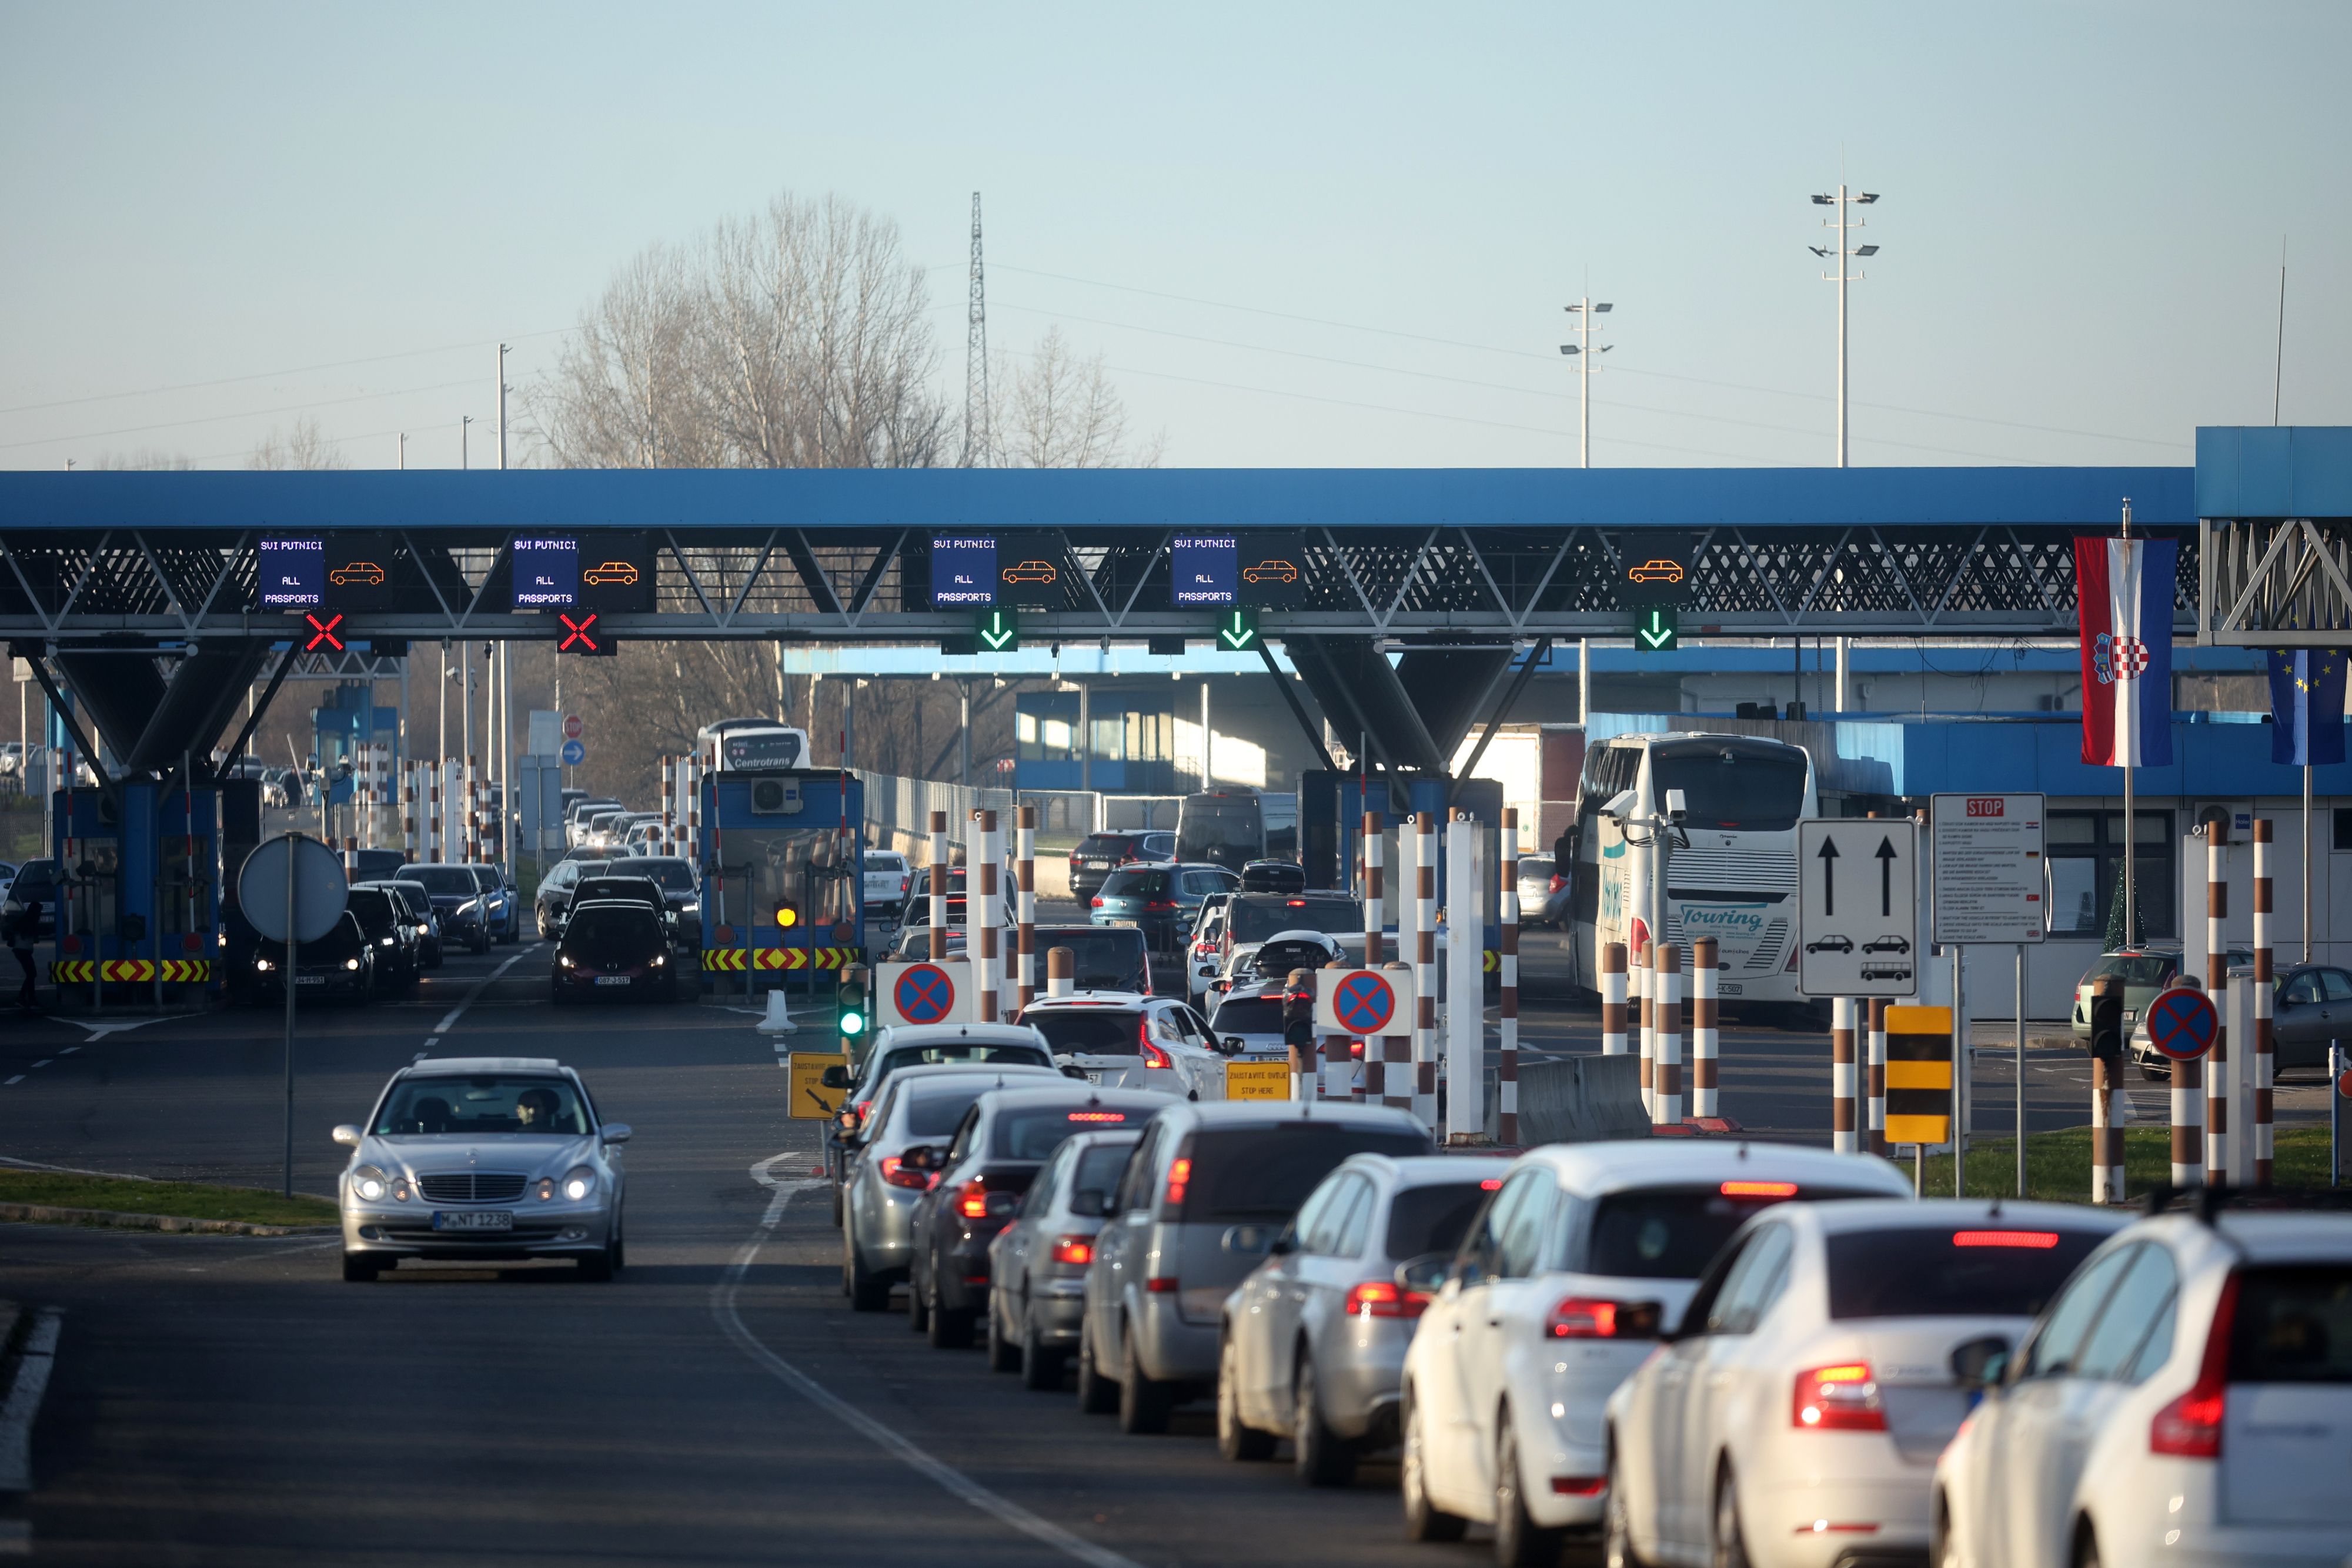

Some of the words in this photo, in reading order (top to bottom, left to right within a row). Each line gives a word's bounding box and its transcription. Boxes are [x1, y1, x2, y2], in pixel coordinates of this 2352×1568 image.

[514, 541, 531, 549] SVI
[535, 541, 575, 549] PUTNICI
[519, 594, 572, 603] PASSPORTS
[566, 722, 581, 732] STOP
[735, 757, 790, 767] Centrotrans
[1969, 800, 2002, 815] STOP
[1681, 904, 1768, 931] Touring
[441, 1213, 450, 1224] M
[458, 1213, 475, 1225] NT
[480, 1212, 510, 1226] 1238
